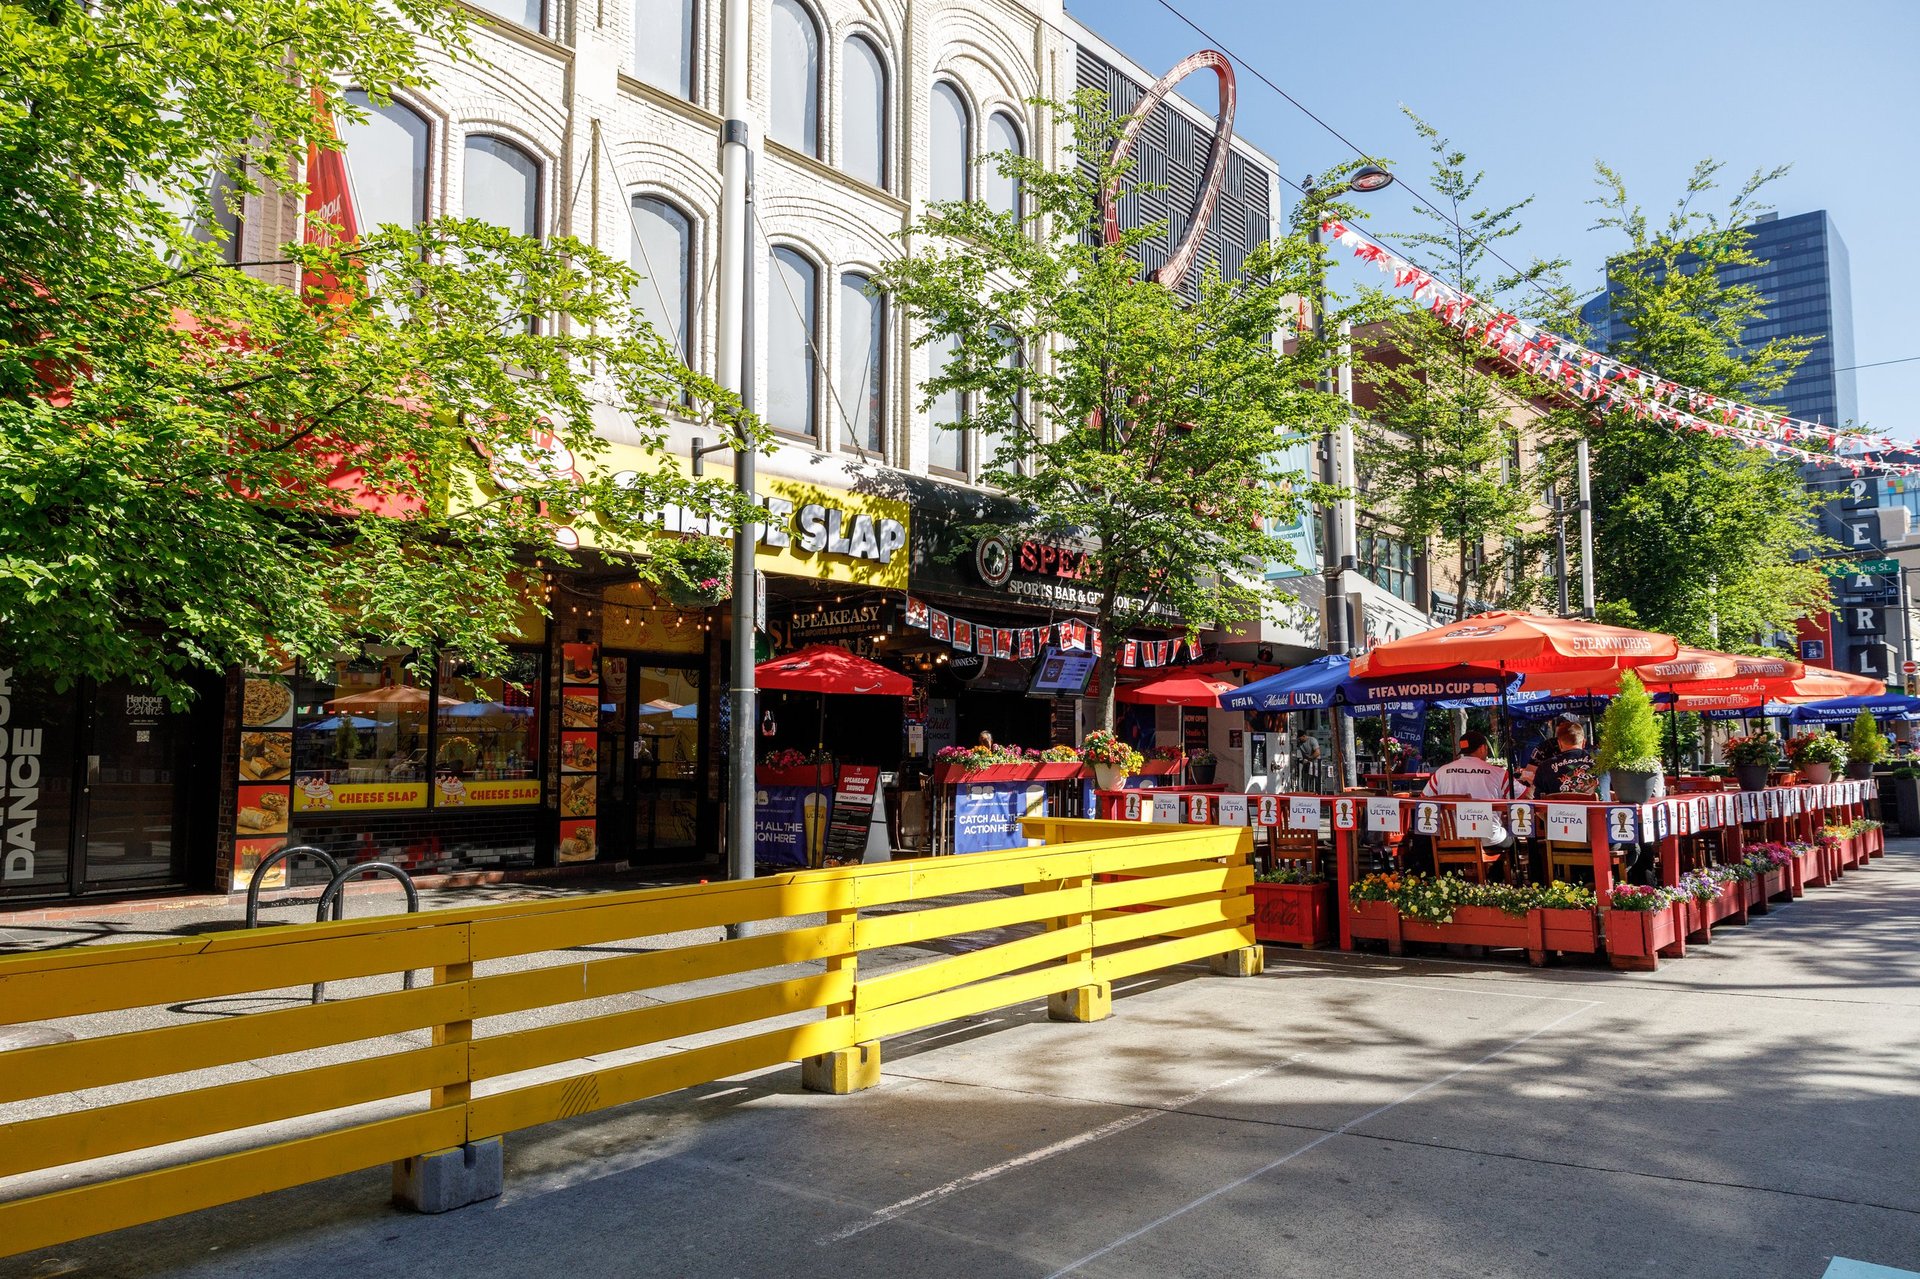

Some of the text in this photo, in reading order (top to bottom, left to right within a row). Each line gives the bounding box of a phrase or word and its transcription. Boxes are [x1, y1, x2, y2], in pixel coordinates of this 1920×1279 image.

[800, 504, 906, 564] SLAP
[1843, 564, 1876, 574] Sthe
[1878, 563, 1892, 571] St.
[1008, 579, 1053, 598] SPORTS
[1054, 586, 1077, 602] BAR
[1077, 589, 1086, 603] &
[792, 606, 880, 629] SPEAKEASY
[1573, 636, 1652, 651] STEAMWORKS
[949, 656, 978, 668] GUINNESS
[1653, 662, 1715, 676] STEAMWORKS
[1736, 663, 1785, 675] EAMWORKS
[1369, 684, 1397, 699] FIFA
[1398, 683, 1444, 696] WORLD
[1445, 682, 1470, 694] CUP
[126, 694, 163, 702] Harbour
[1231, 697, 1247, 708] FIFA
[1294, 692, 1324, 705] ULTRA
[1686, 695, 1750, 707] STEAMWORKS
[1367, 702, 1387, 712] WORD
[1388, 702, 1401, 711] CUP
[1525, 704, 1546, 713] FIFA
[1710, 709, 1741, 717] ULTRA
[1393, 730, 1421, 741] ULTRA
[1551, 755, 1597, 773] Yokosuka
[1446, 767, 1491, 776] ENGLAND
[844, 776, 870, 785] SPEAKEASY
[338, 790, 418, 804] CHEESE SLAP
[470, 788, 539, 801] CHEESE SLAP
[4, 728, 43, 880] DANCE
[1221, 804, 1244, 813] ULTRA
[1292, 807, 1317, 815] ULTRA
[1370, 808, 1397, 816] ULTRA
[959, 814, 988, 825] CATCH
[989, 812, 1007, 822] ALL
[1459, 813, 1489, 821] ULTRA
[1550, 815, 1583, 825] ULTRA
[765, 822, 783, 831] ALL
[784, 823, 803, 832] THE
[963, 823, 1019, 835] ACTION HERE
[773, 834, 796, 844] HERE
